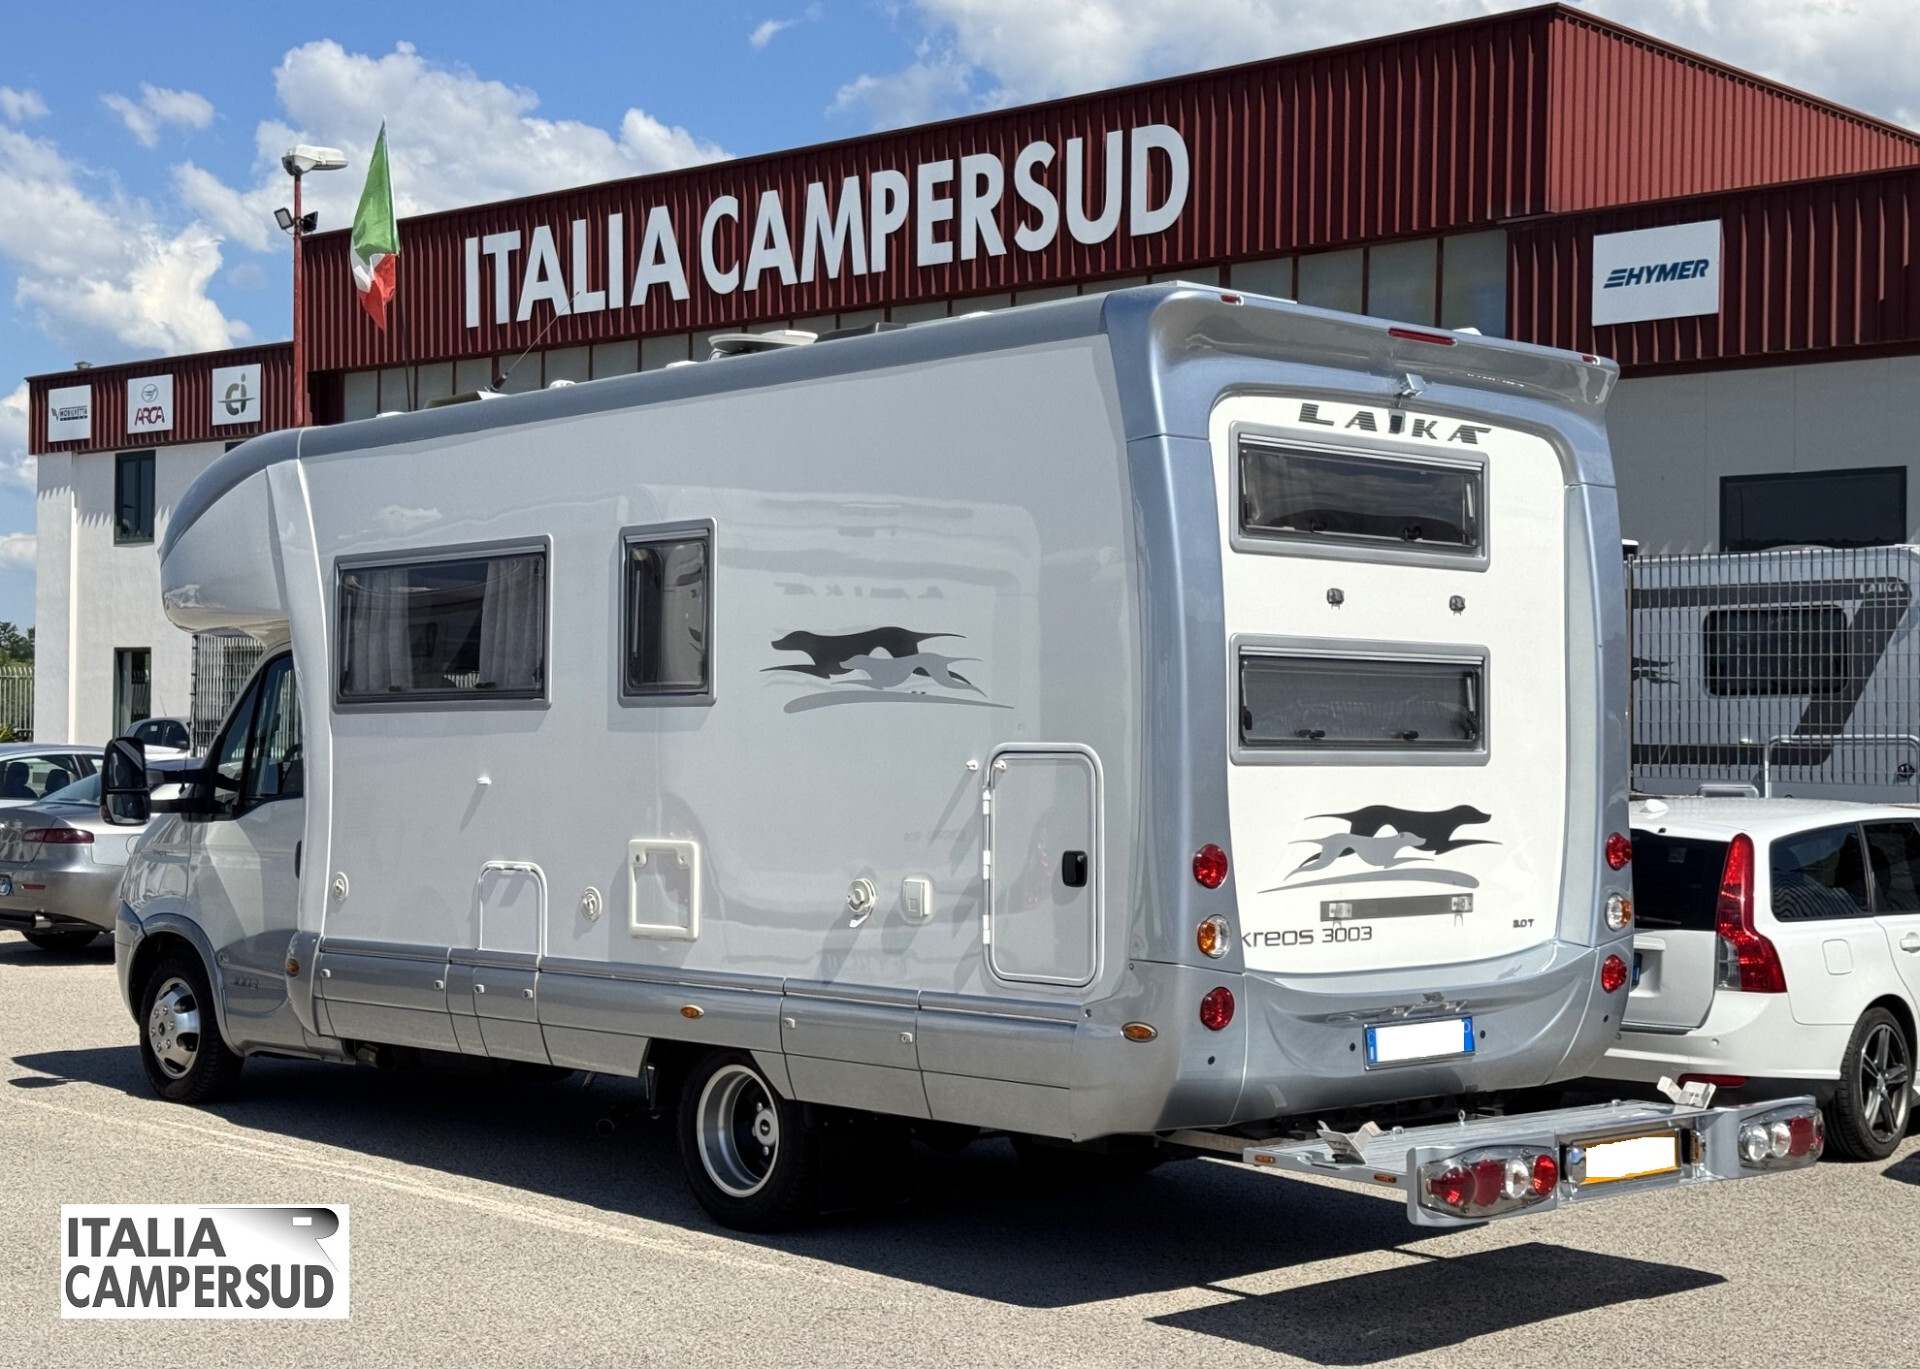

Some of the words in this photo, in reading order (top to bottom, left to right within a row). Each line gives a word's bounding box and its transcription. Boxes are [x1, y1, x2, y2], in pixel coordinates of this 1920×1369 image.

[465, 205, 690, 328] ITALIA
[700, 124, 1190, 295] CAMPERSUD
[1624, 258, 1710, 287] HYMER
[134, 405, 165, 426] ARCA
[1298, 402, 1492, 444] LAIKA
[1322, 926, 1372, 943] 3003
